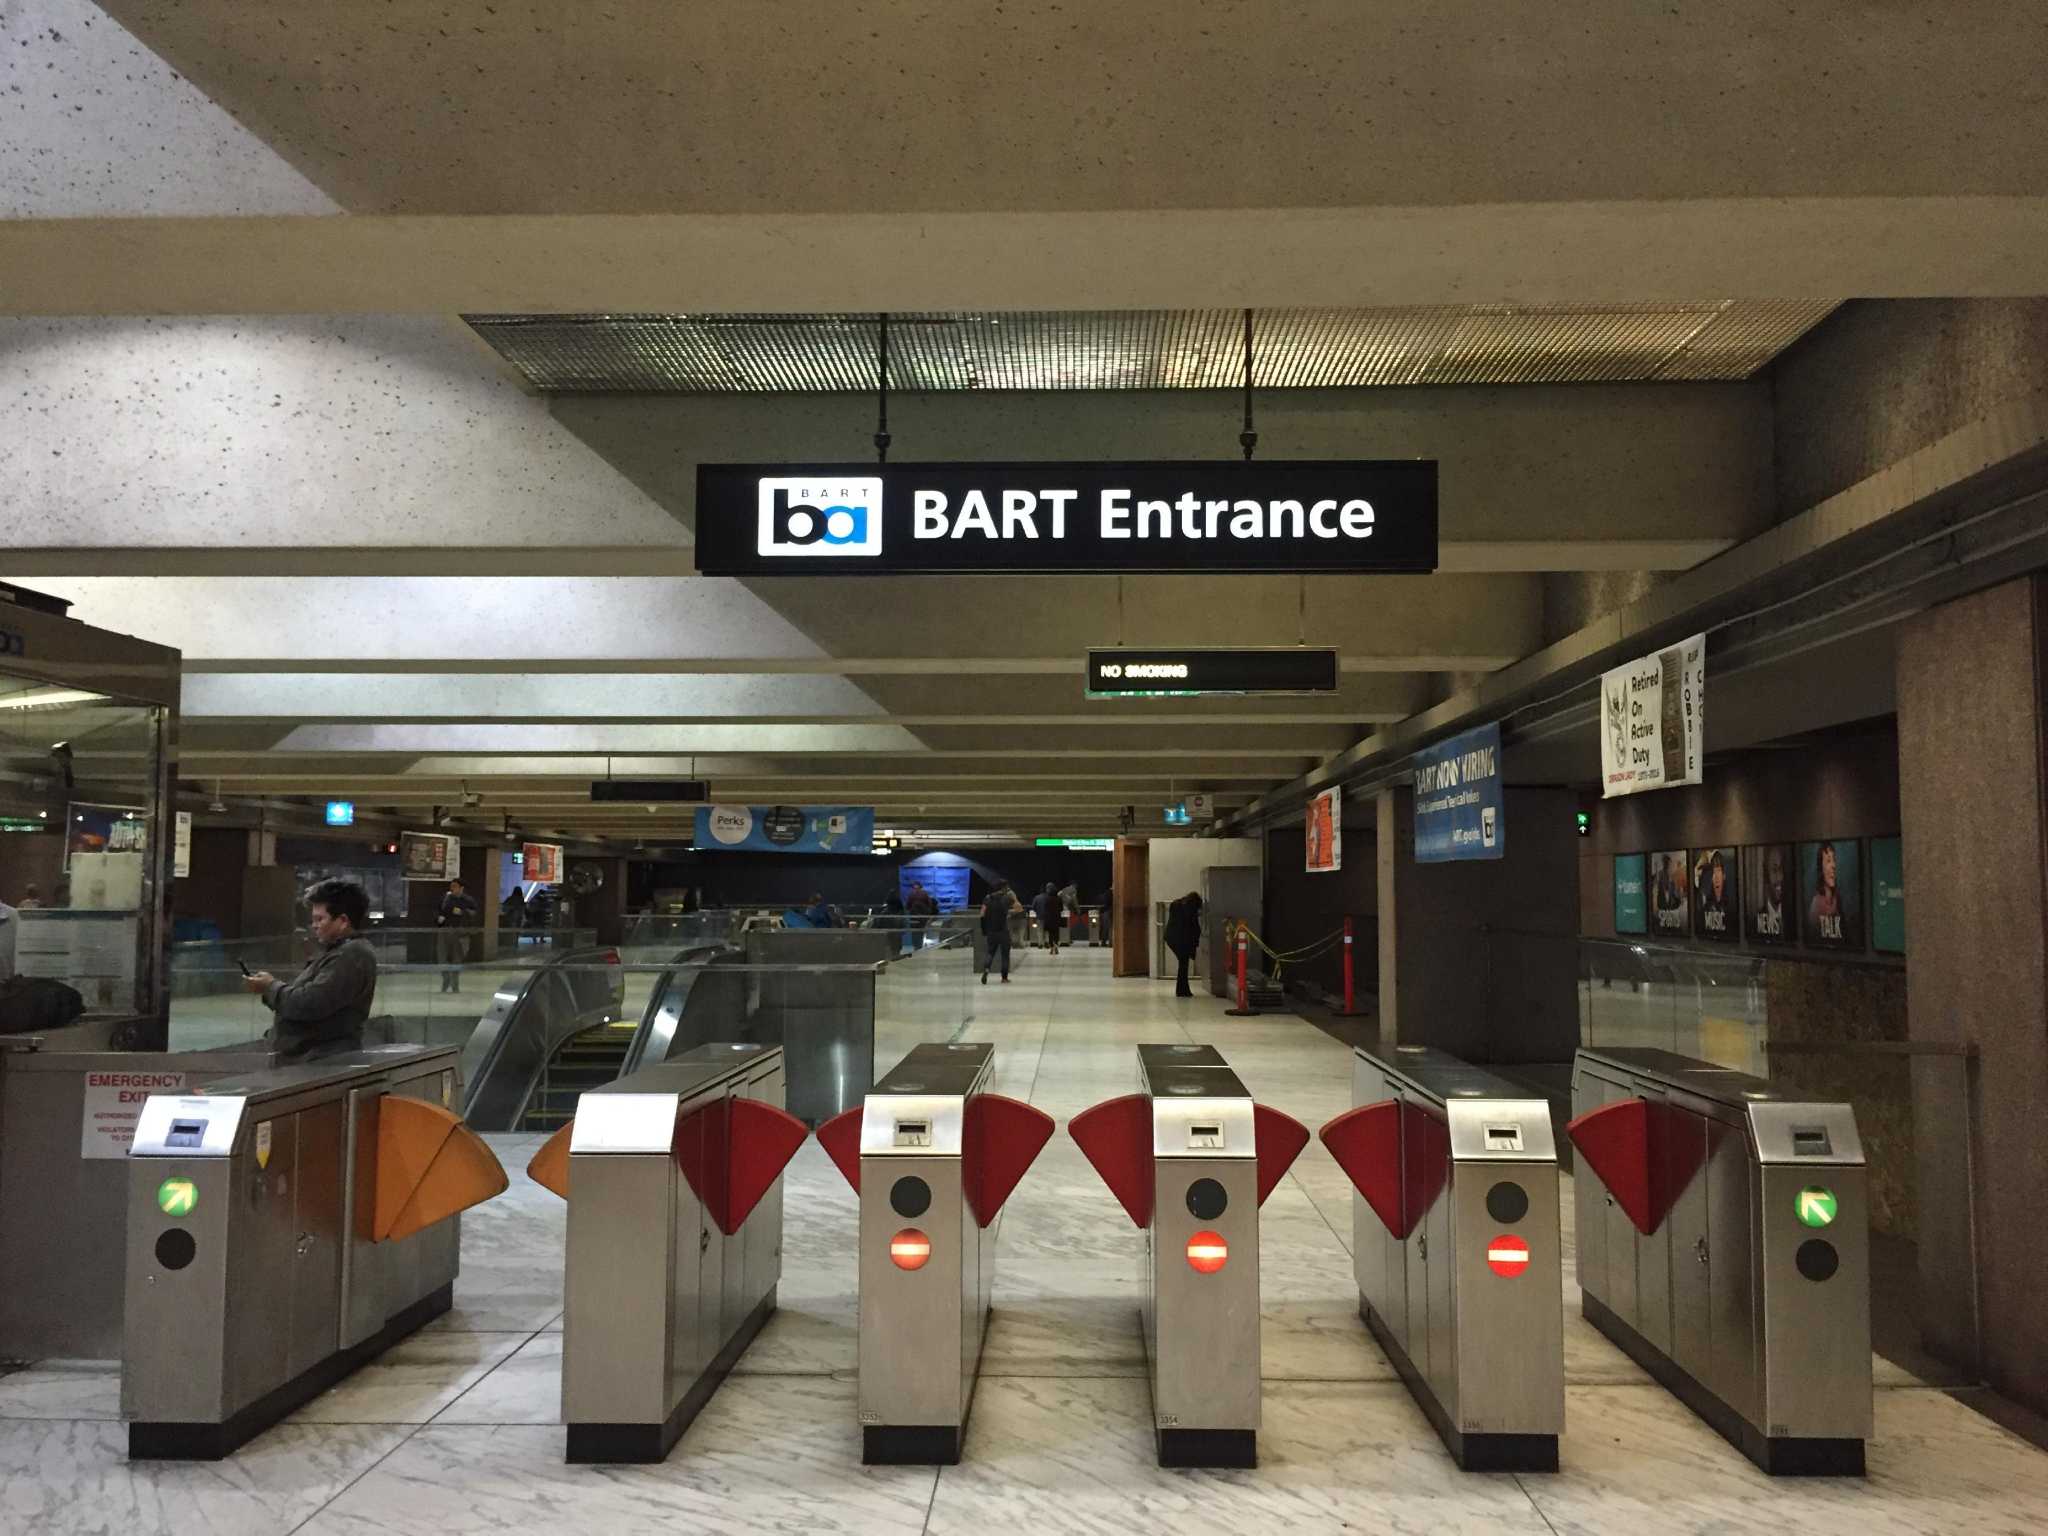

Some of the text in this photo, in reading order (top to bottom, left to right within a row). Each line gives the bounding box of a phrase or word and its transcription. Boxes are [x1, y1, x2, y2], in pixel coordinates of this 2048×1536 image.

[801, 489, 868, 497] BART
[913, 489, 1376, 539] BART Entrance
[1100, 665, 1188, 678] NO SMOKING
[1631, 668, 1659, 692] Retired
[1631, 700, 1643, 718] On
[1631, 720, 1654, 740] Active
[1632, 747, 1650, 766] Duty
[1437, 757, 1460, 790] NOW
[717, 815, 745, 827] Perks
[1704, 911, 1726, 931] MUSIC
[1758, 912, 1781, 935] NEWS
[1819, 915, 1842, 938] TALK
[89, 1075, 182, 1087] EMERGENCY
